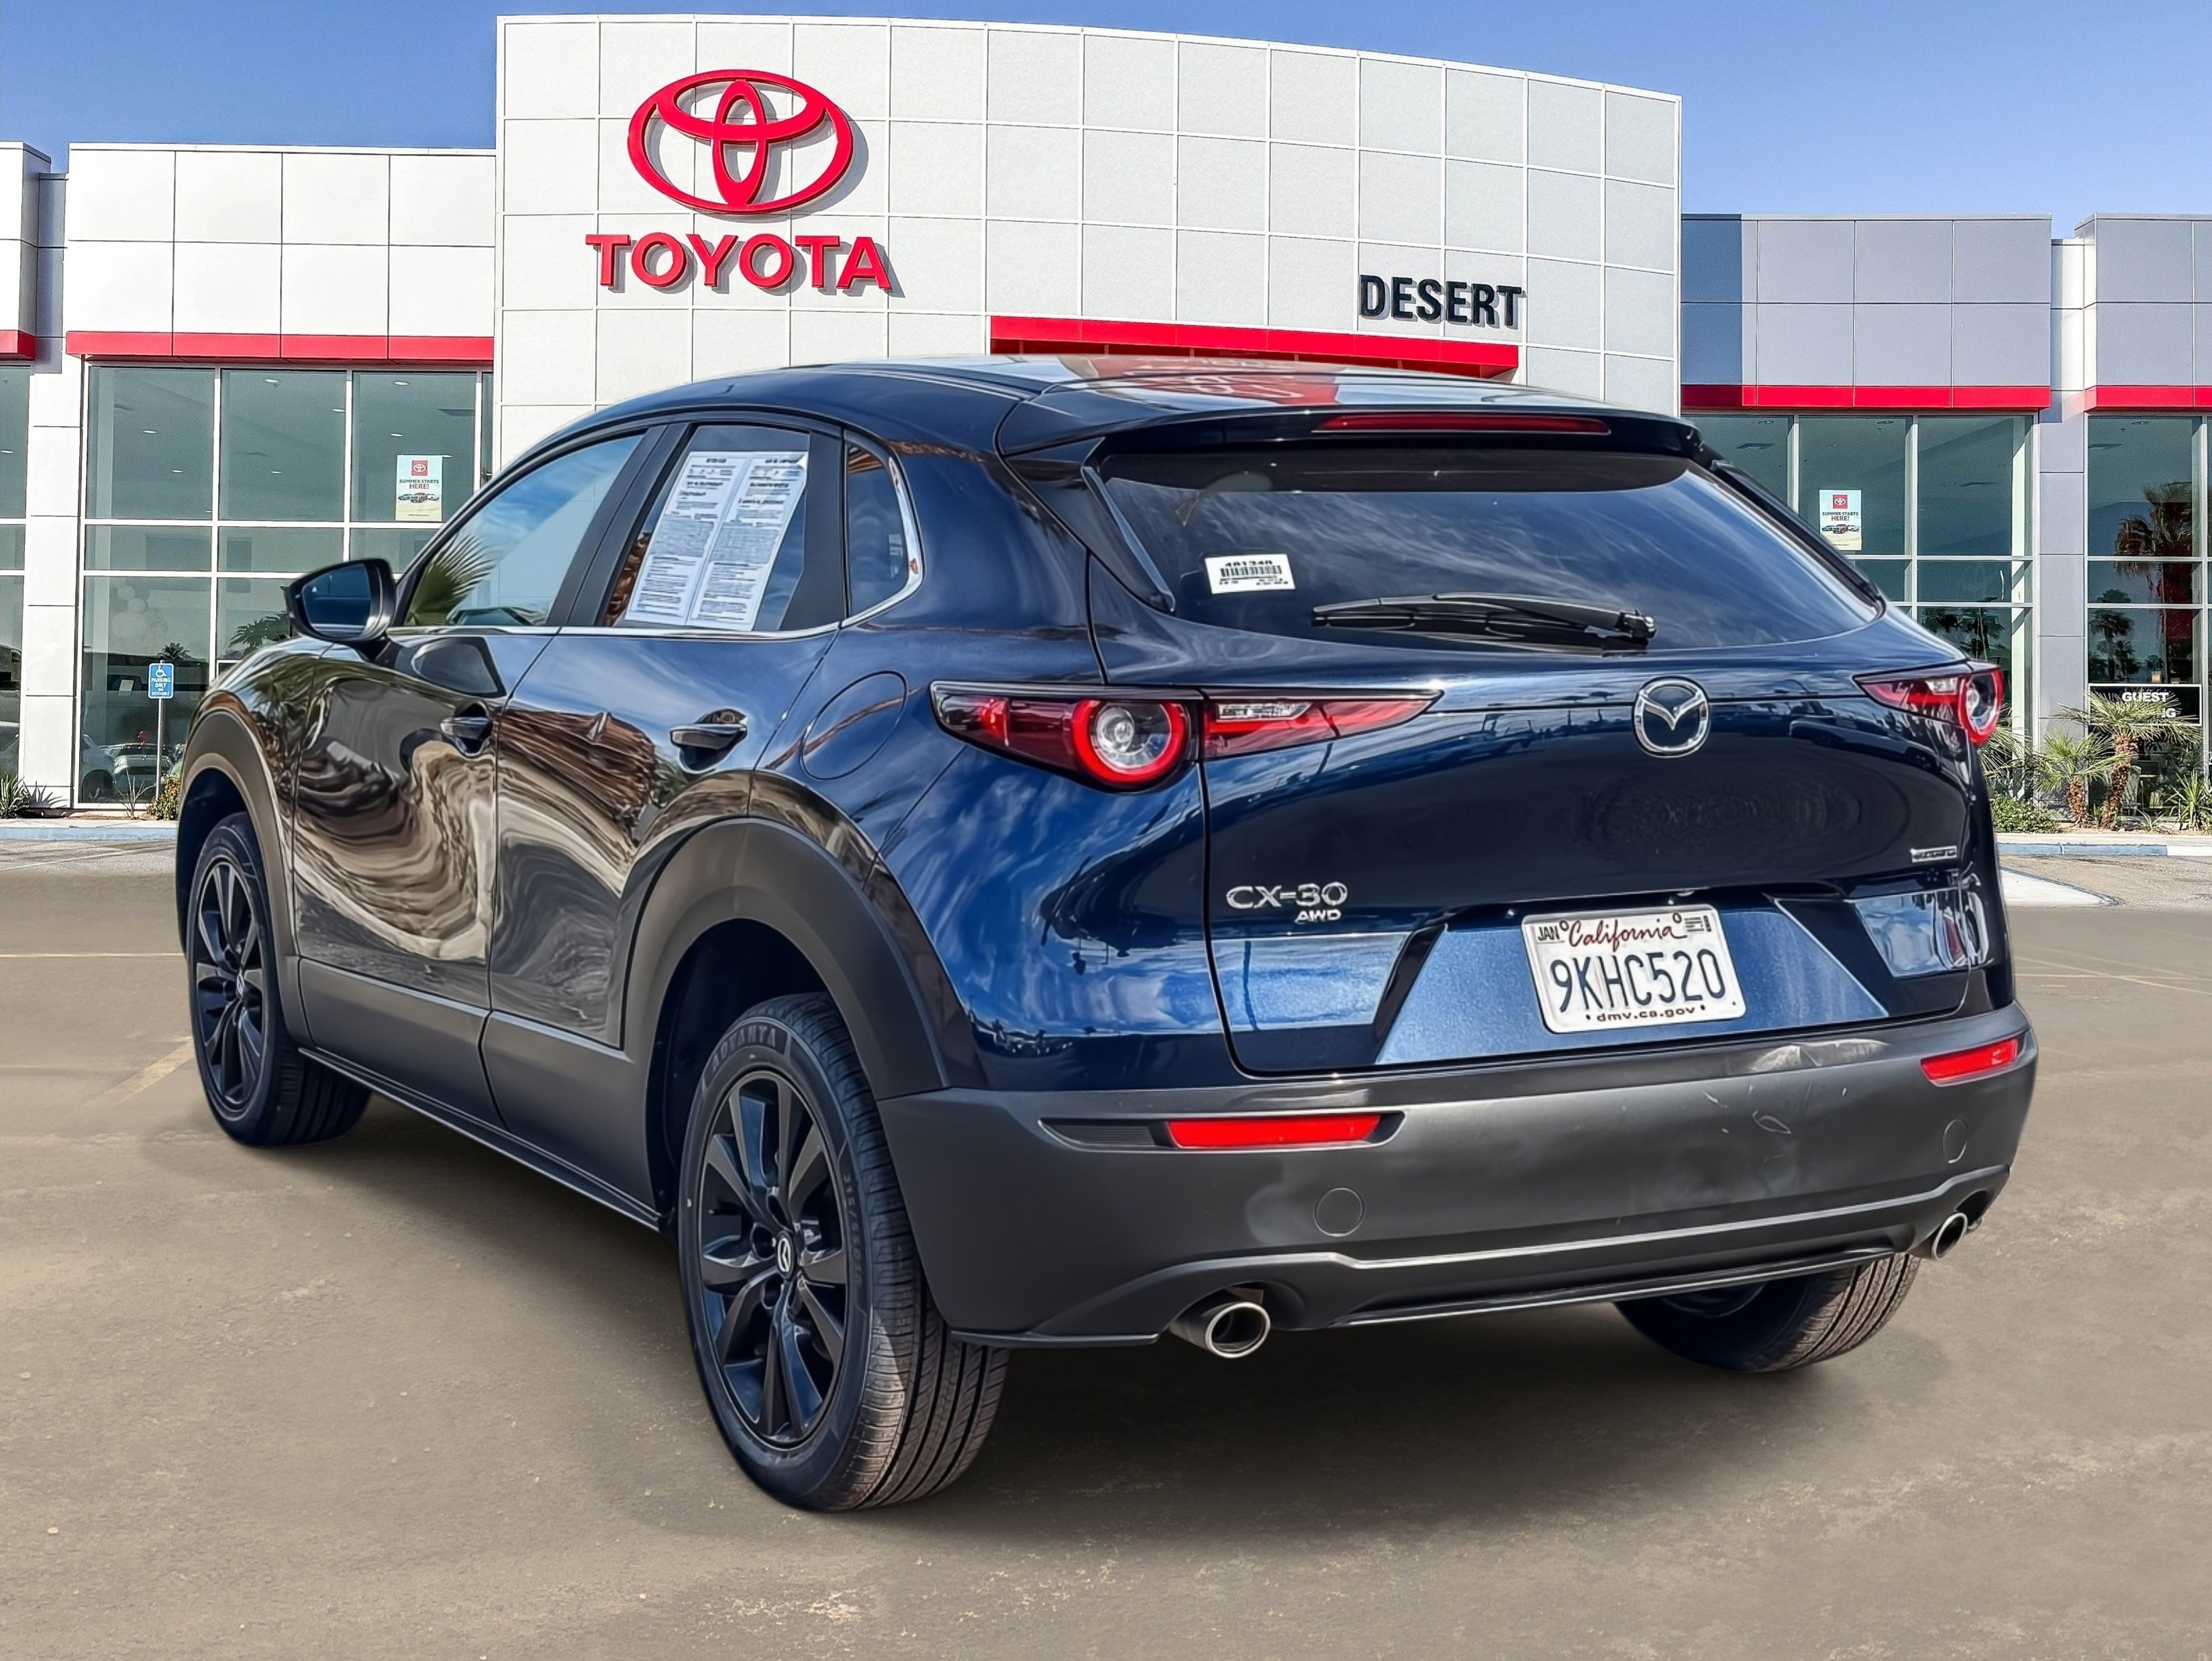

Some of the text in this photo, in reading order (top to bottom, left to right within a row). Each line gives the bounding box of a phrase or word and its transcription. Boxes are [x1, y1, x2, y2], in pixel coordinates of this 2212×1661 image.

[585, 232, 893, 289] TOYOTA
[1359, 274, 1522, 326] DESERT
[2122, 692, 2169, 703] GUEST
[1225, 881, 1348, 909] CX-30
[1295, 909, 1342, 925] AWD
[1538, 925, 1560, 942] JAN
[1568, 918, 1688, 952] California
[1550, 948, 1726, 1013] 9KHC520
[1597, 1007, 1695, 1022] dmv.ca.gov
[712, 1025, 776, 1072] ADVANTA
